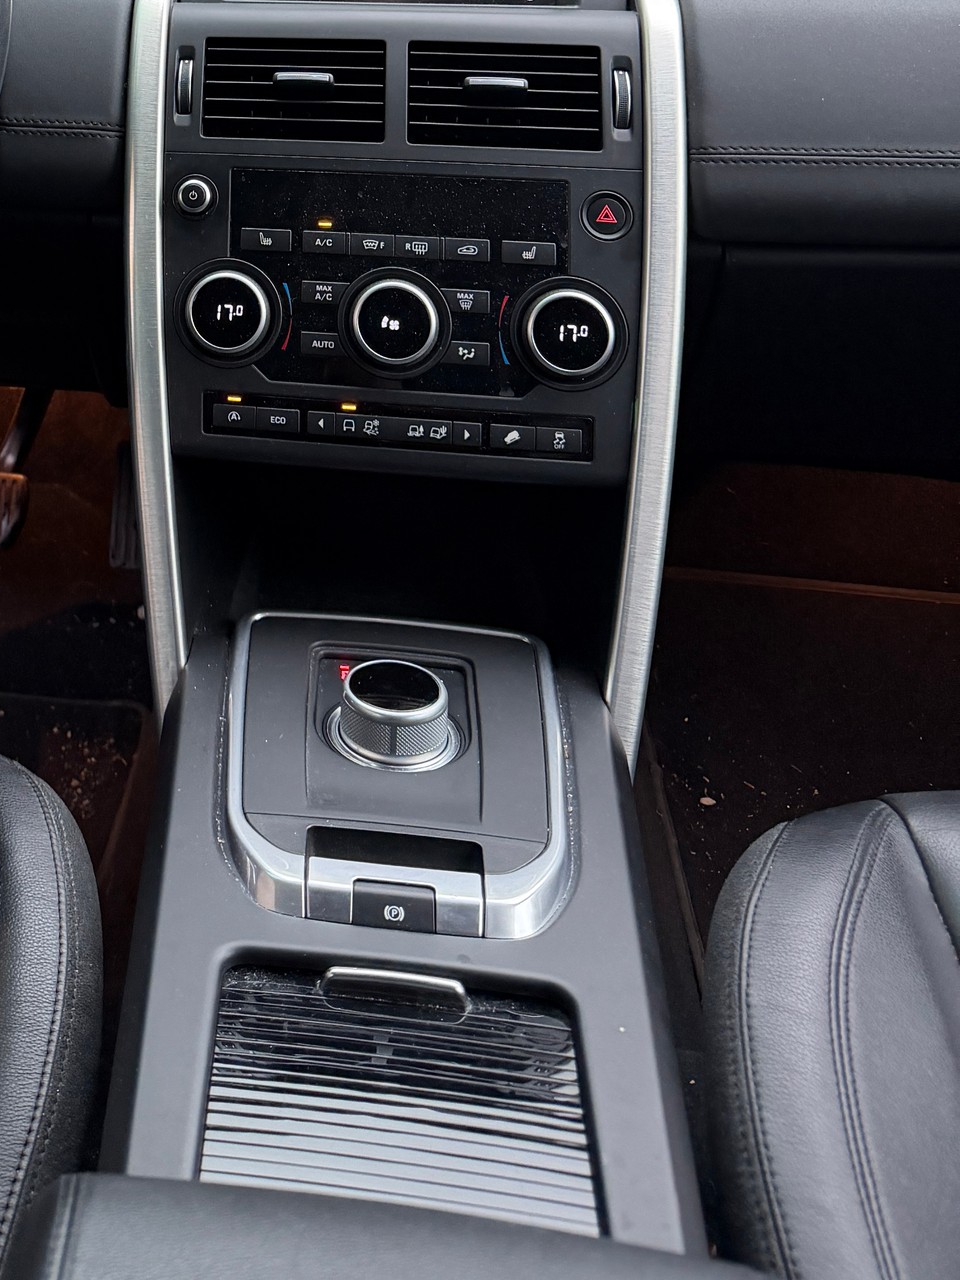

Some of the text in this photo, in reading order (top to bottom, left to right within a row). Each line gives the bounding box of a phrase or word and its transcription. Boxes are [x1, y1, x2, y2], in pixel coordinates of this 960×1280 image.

[315, 238, 333, 247] A/C
[316, 284, 333, 292] MAX
[315, 292, 333, 301] A/C
[457, 292, 474, 300] MAX
[216, 304, 244, 321] 17.0
[312, 340, 335, 349] AUTO
[270, 416, 286, 424] ECO
